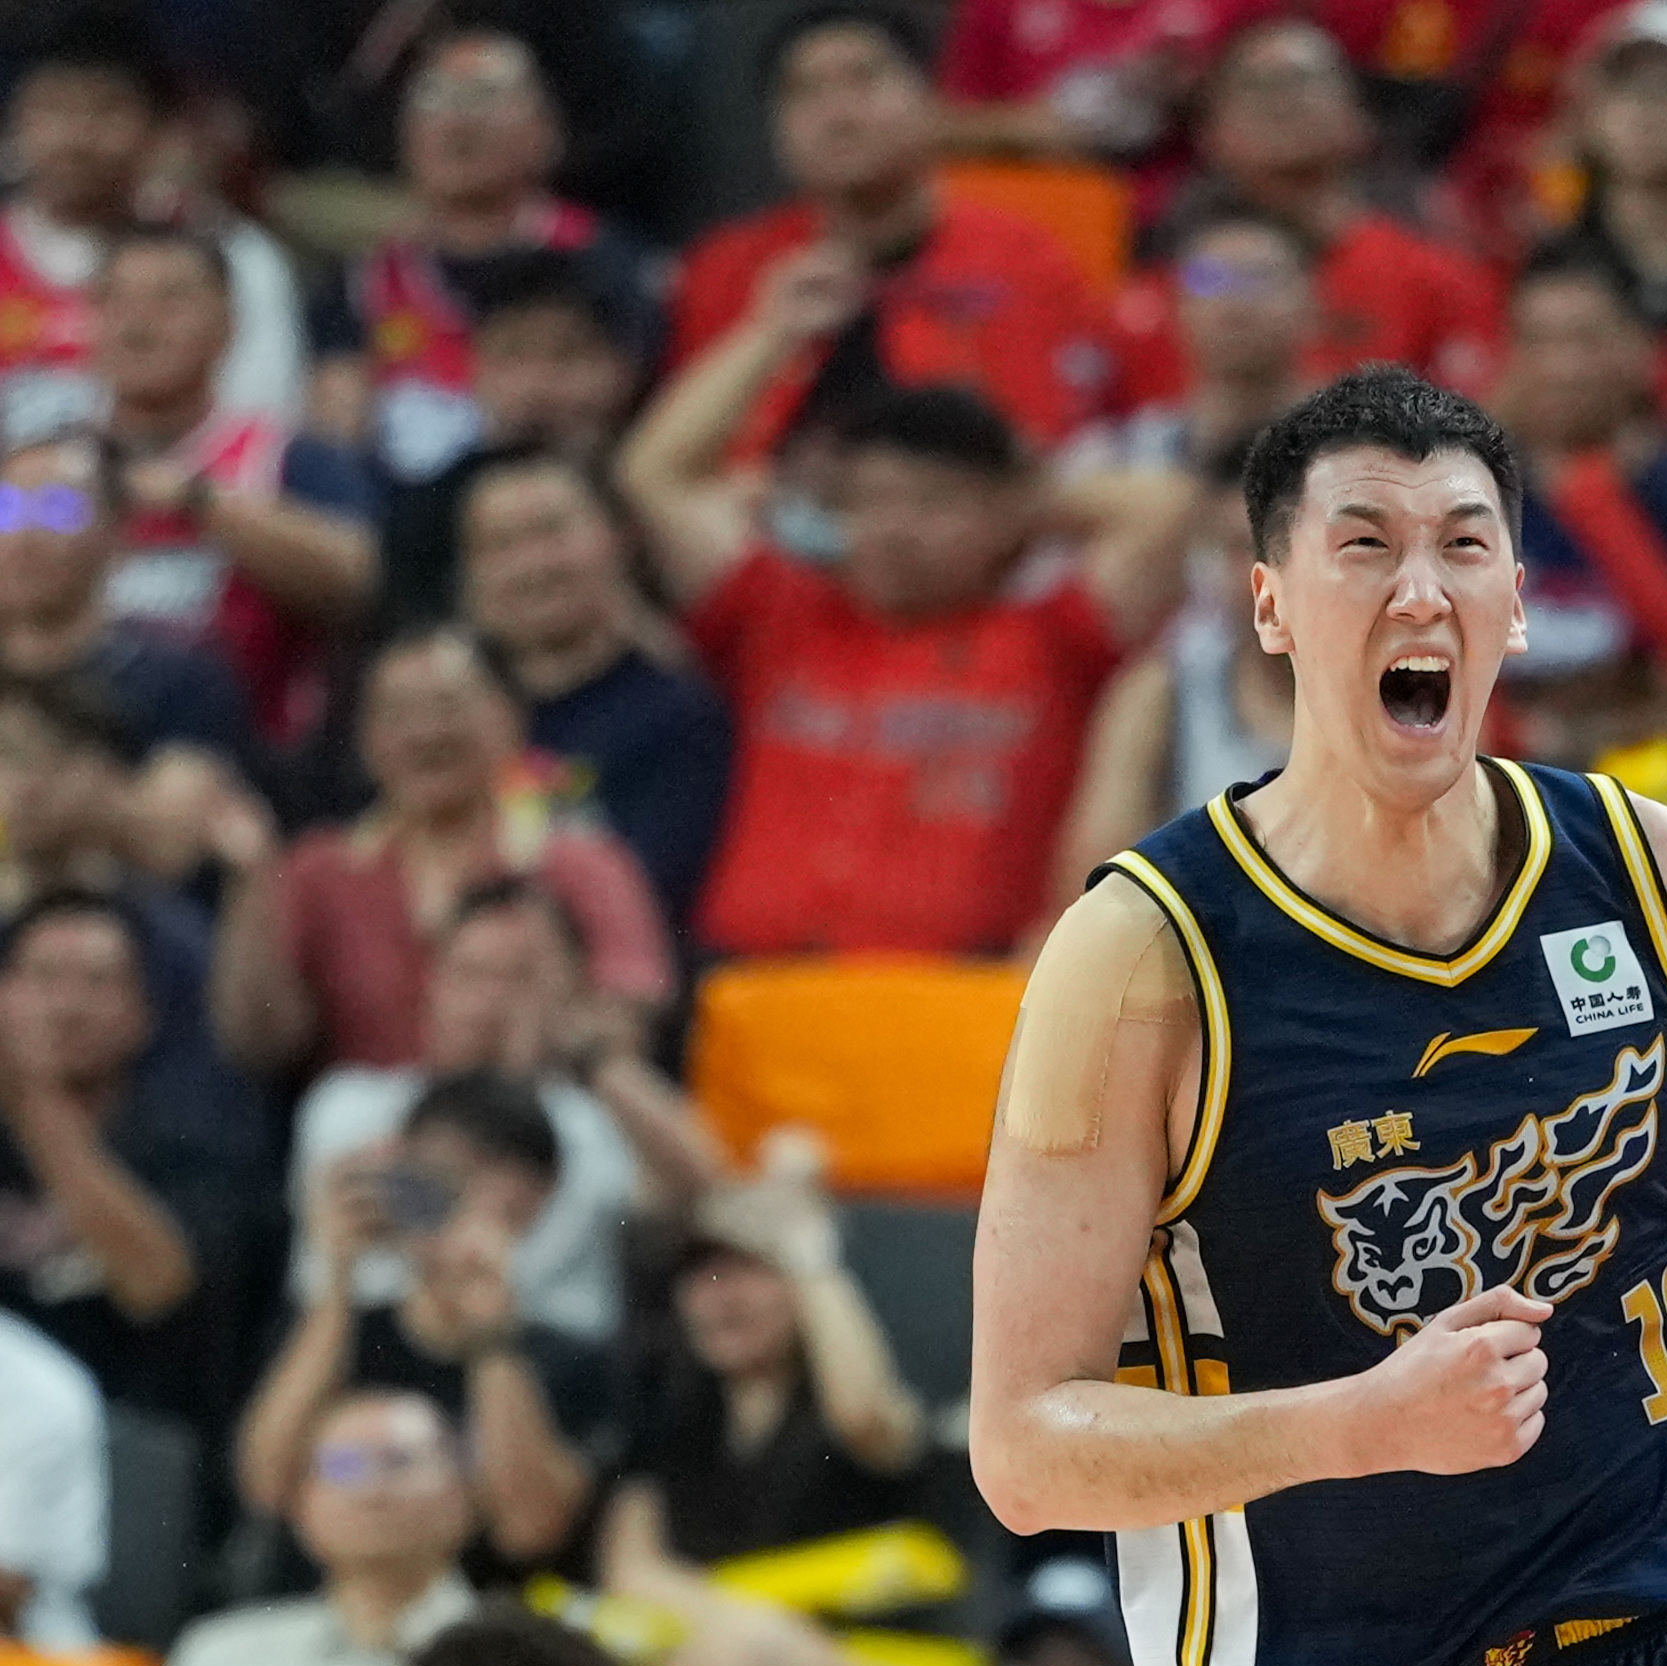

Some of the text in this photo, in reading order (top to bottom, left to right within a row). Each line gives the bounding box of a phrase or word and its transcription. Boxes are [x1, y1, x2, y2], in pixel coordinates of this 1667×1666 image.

[1570, 985, 1642, 1013] 中国人寿
[1575, 1003, 1645, 1024] CHINA LIFE
[1326, 1109, 1421, 1171] 廣東
